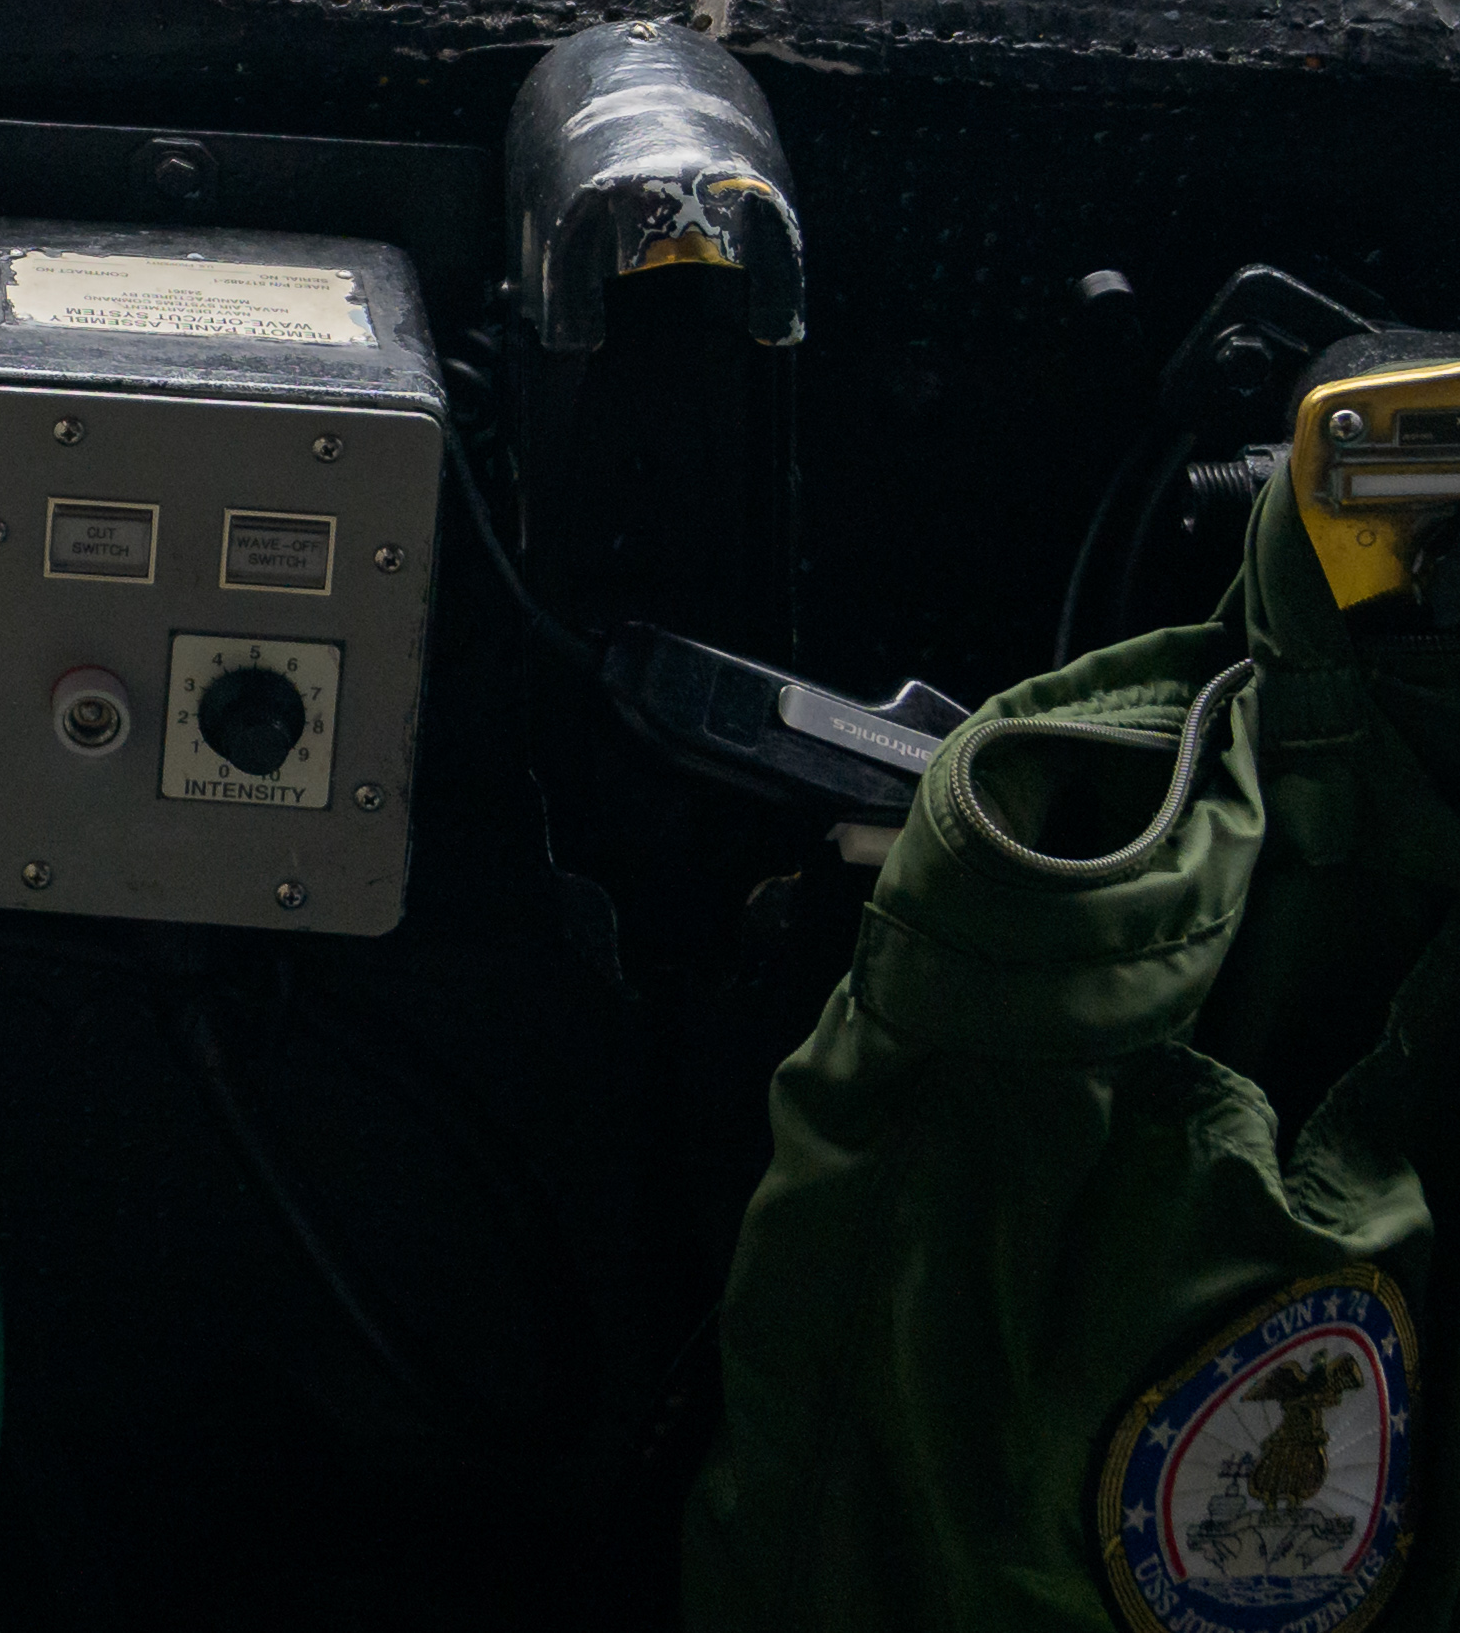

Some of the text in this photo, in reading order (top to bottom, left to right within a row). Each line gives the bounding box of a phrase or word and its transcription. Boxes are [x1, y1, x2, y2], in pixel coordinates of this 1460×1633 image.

[57, 268, 128, 277] CONTRACT
[282, 275, 329, 284] SERIAL
[83, 295, 151, 304] COMMAND
[141, 292, 250, 305] MANUFACTURED
[154, 299, 216, 309] SYSTEMS
[123, 304, 212, 315] DEPARTMENT
[244, 305, 289, 314] NAVAL
[65, 307, 312, 331] WAVE-OFF/CUT SYSTEM
[49, 314, 332, 340] REMOTE PANEL ASSEMBLY
[86, 526, 118, 542] CUT
[71, 540, 130, 558] SWITCH
[236, 537, 320, 555] WAVE-OFF
[248, 551, 308, 570] SWITCH
[249, 645, 261, 660] 5
[287, 658, 299, 672] 6
[183, 678, 195, 692] 3
[178, 710, 189, 725] 2
[183, 779, 306, 804] INTENSITY
[1260, 1297, 1314, 1347] CVN
[1134, 1553, 1181, 1617] USS
